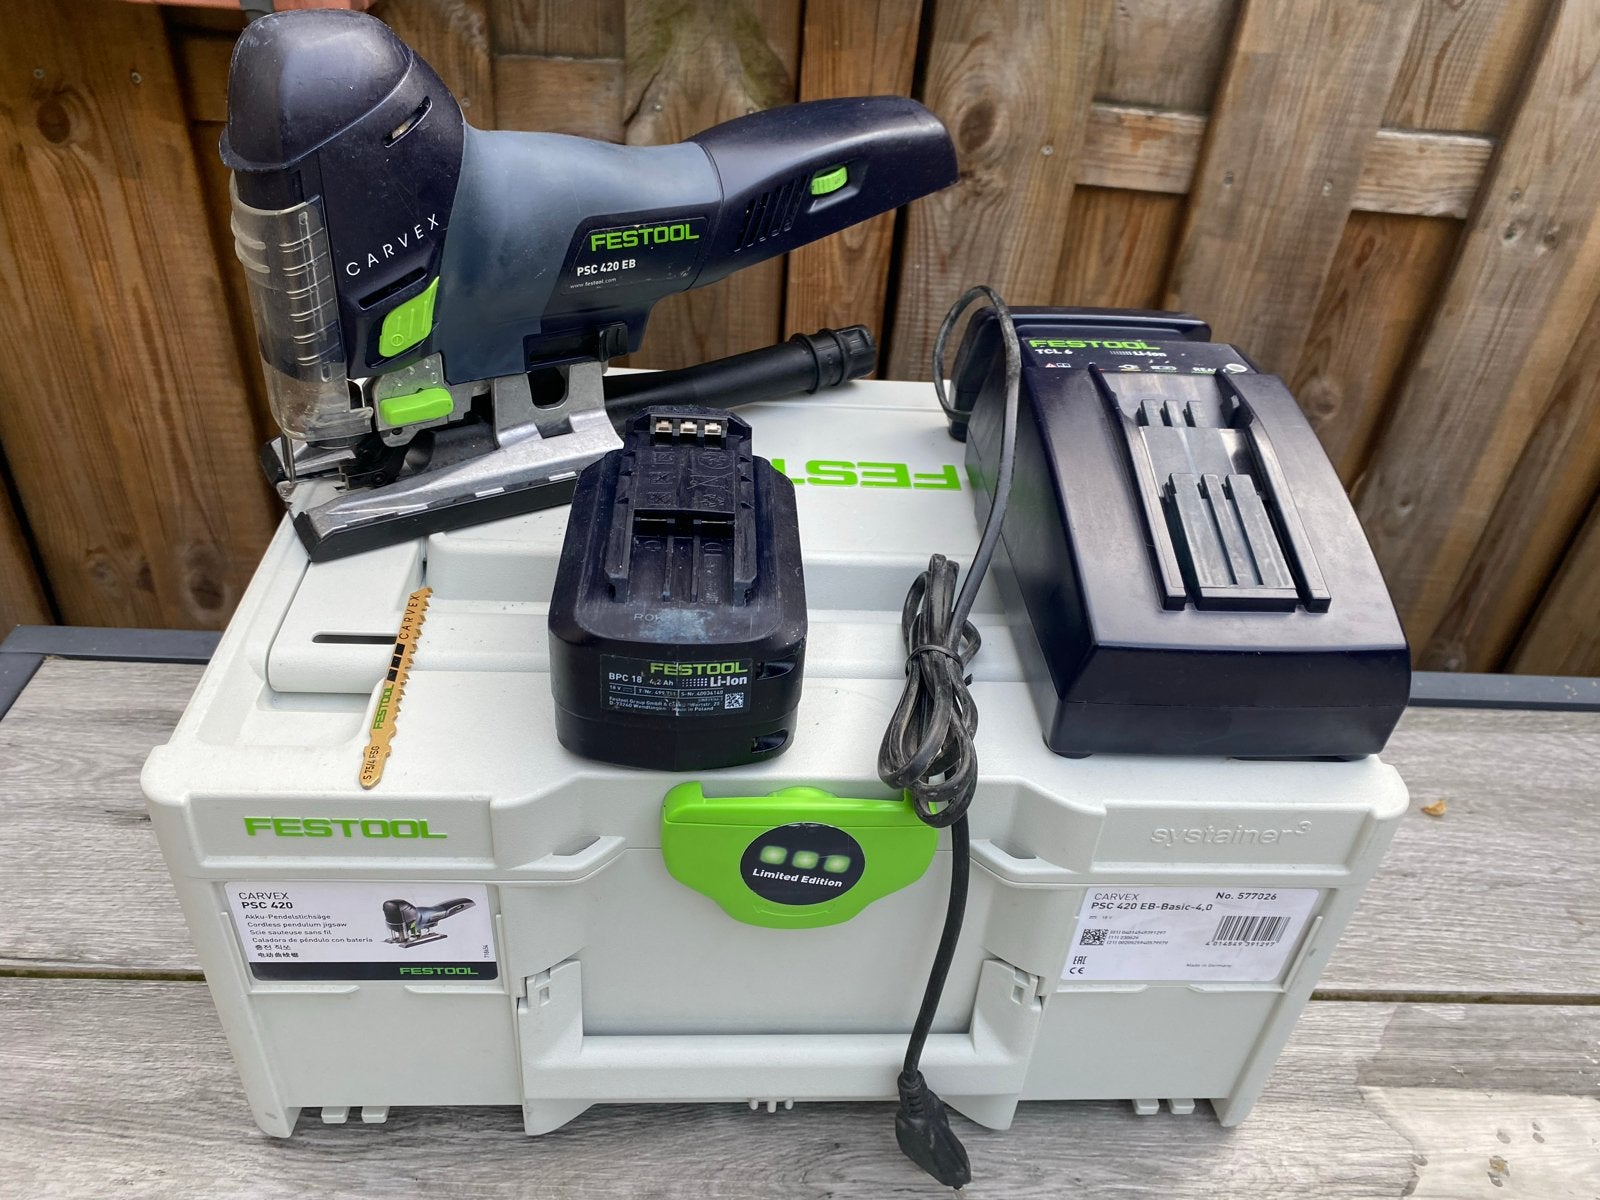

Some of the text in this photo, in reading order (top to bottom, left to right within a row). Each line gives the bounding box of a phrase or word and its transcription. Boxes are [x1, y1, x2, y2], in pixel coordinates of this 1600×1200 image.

[346, 214, 439, 275] CARVEX
[591, 224, 699, 251] FESTOOL
[577, 259, 636, 276] PSC 420 EB
[1029, 340, 1160, 350] FESTOOL
[399, 595, 421, 640] CARVEX
[650, 662, 748, 676] FESTOOL
[609, 672, 629, 682] BPC
[632, 675, 643, 683] 18
[710, 676, 748, 687] Li-Ion
[373, 684, 394, 729] FESTOOL
[369, 745, 380, 759] FSG
[243, 816, 448, 839] FESTOOL
[752, 868, 843, 887] Limited Edition
[238, 892, 289, 900] CARVEX
[1094, 893, 1140, 901] CARVEX
[1215, 892, 1278, 901] No. 577026
[241, 901, 293, 909] PSC 420
[1091, 902, 1213, 912] PSC 420 EB-Basic-4,0
[399, 967, 480, 975] FESTOOL
